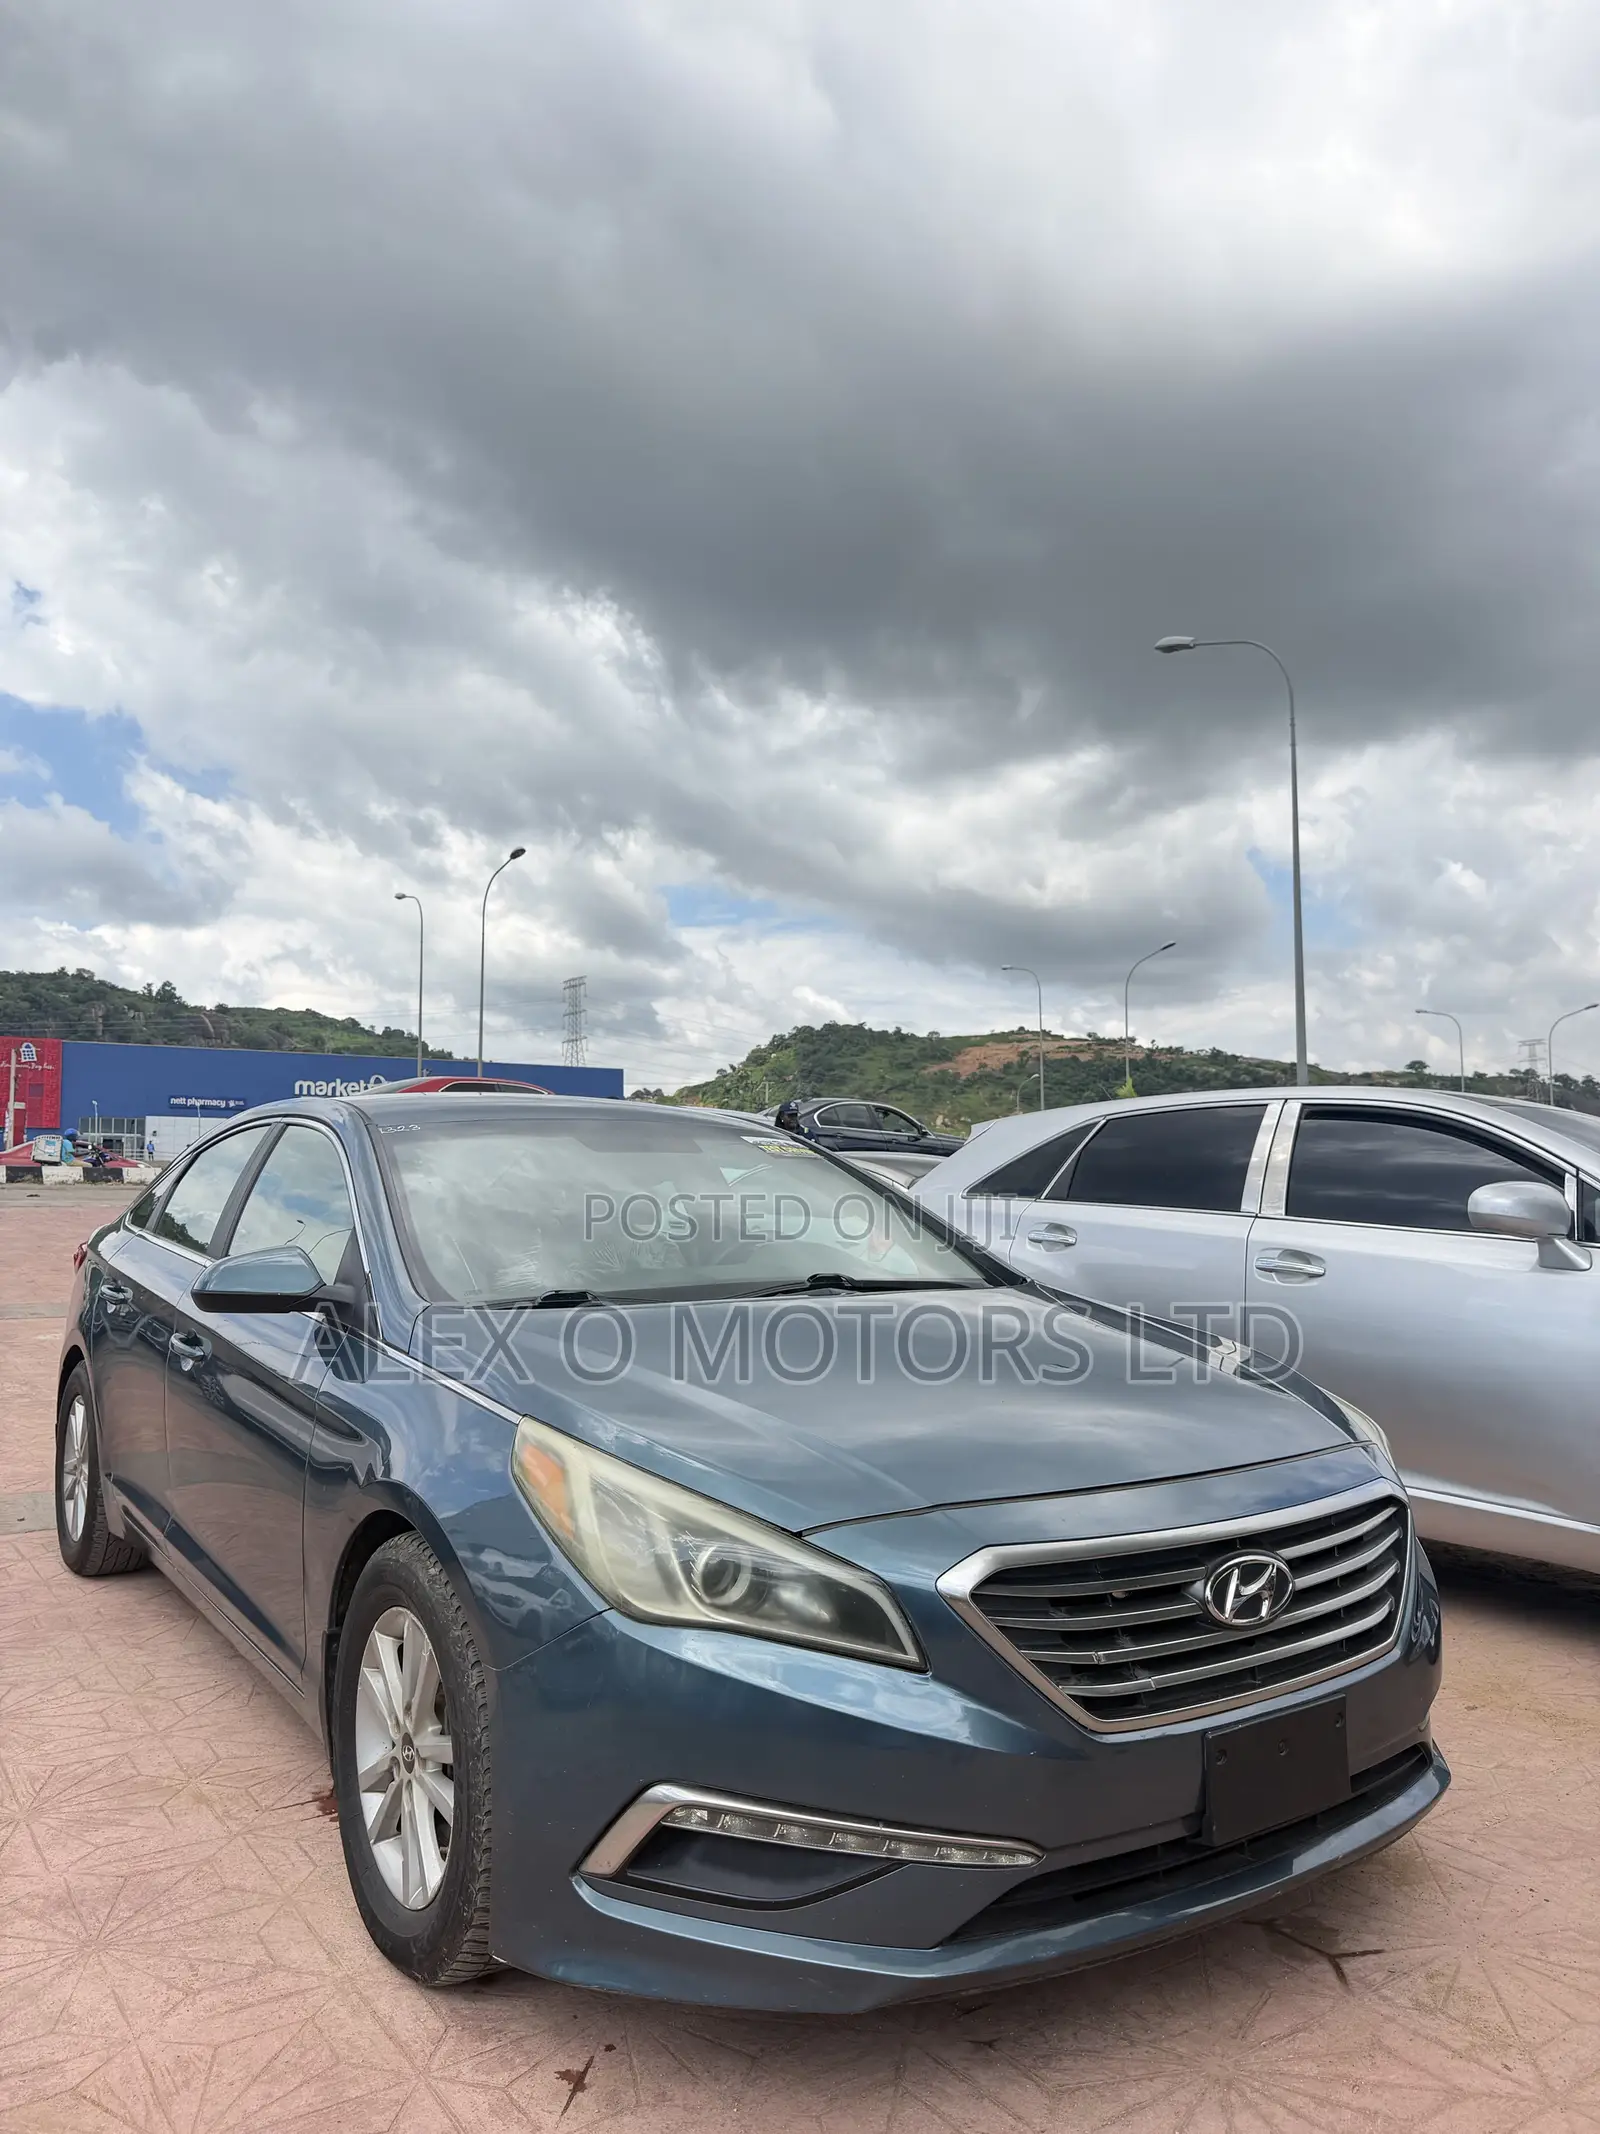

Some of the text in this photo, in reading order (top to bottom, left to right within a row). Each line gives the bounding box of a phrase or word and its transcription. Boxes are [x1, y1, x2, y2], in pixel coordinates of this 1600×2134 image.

[294, 1078, 368, 1097] market
[170, 1097, 186, 1105] nett
[187, 1097, 226, 1108] pharmacy
